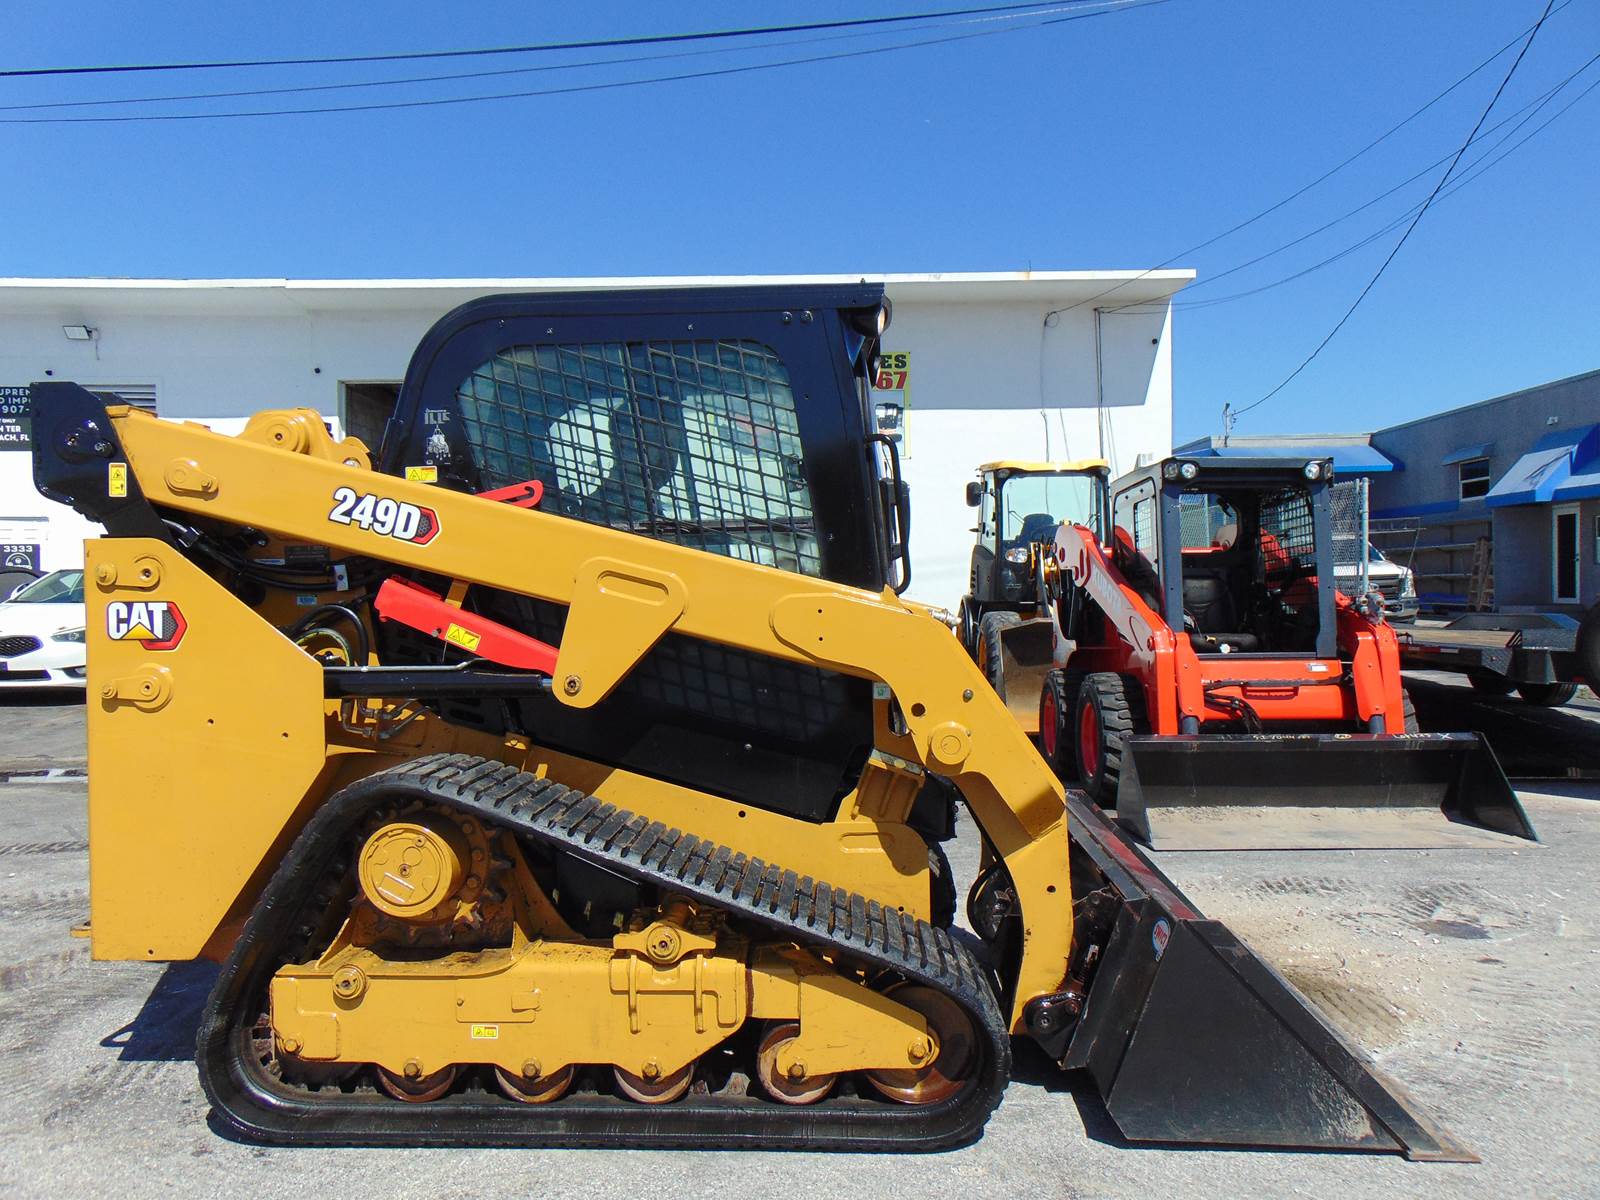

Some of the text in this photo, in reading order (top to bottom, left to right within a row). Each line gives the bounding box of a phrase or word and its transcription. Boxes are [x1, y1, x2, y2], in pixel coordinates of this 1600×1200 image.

[876, 371, 907, 389] 67
[328, 487, 421, 541] 249D
[3, 545, 33, 553] 3333
[107, 602, 168, 640] CAT
